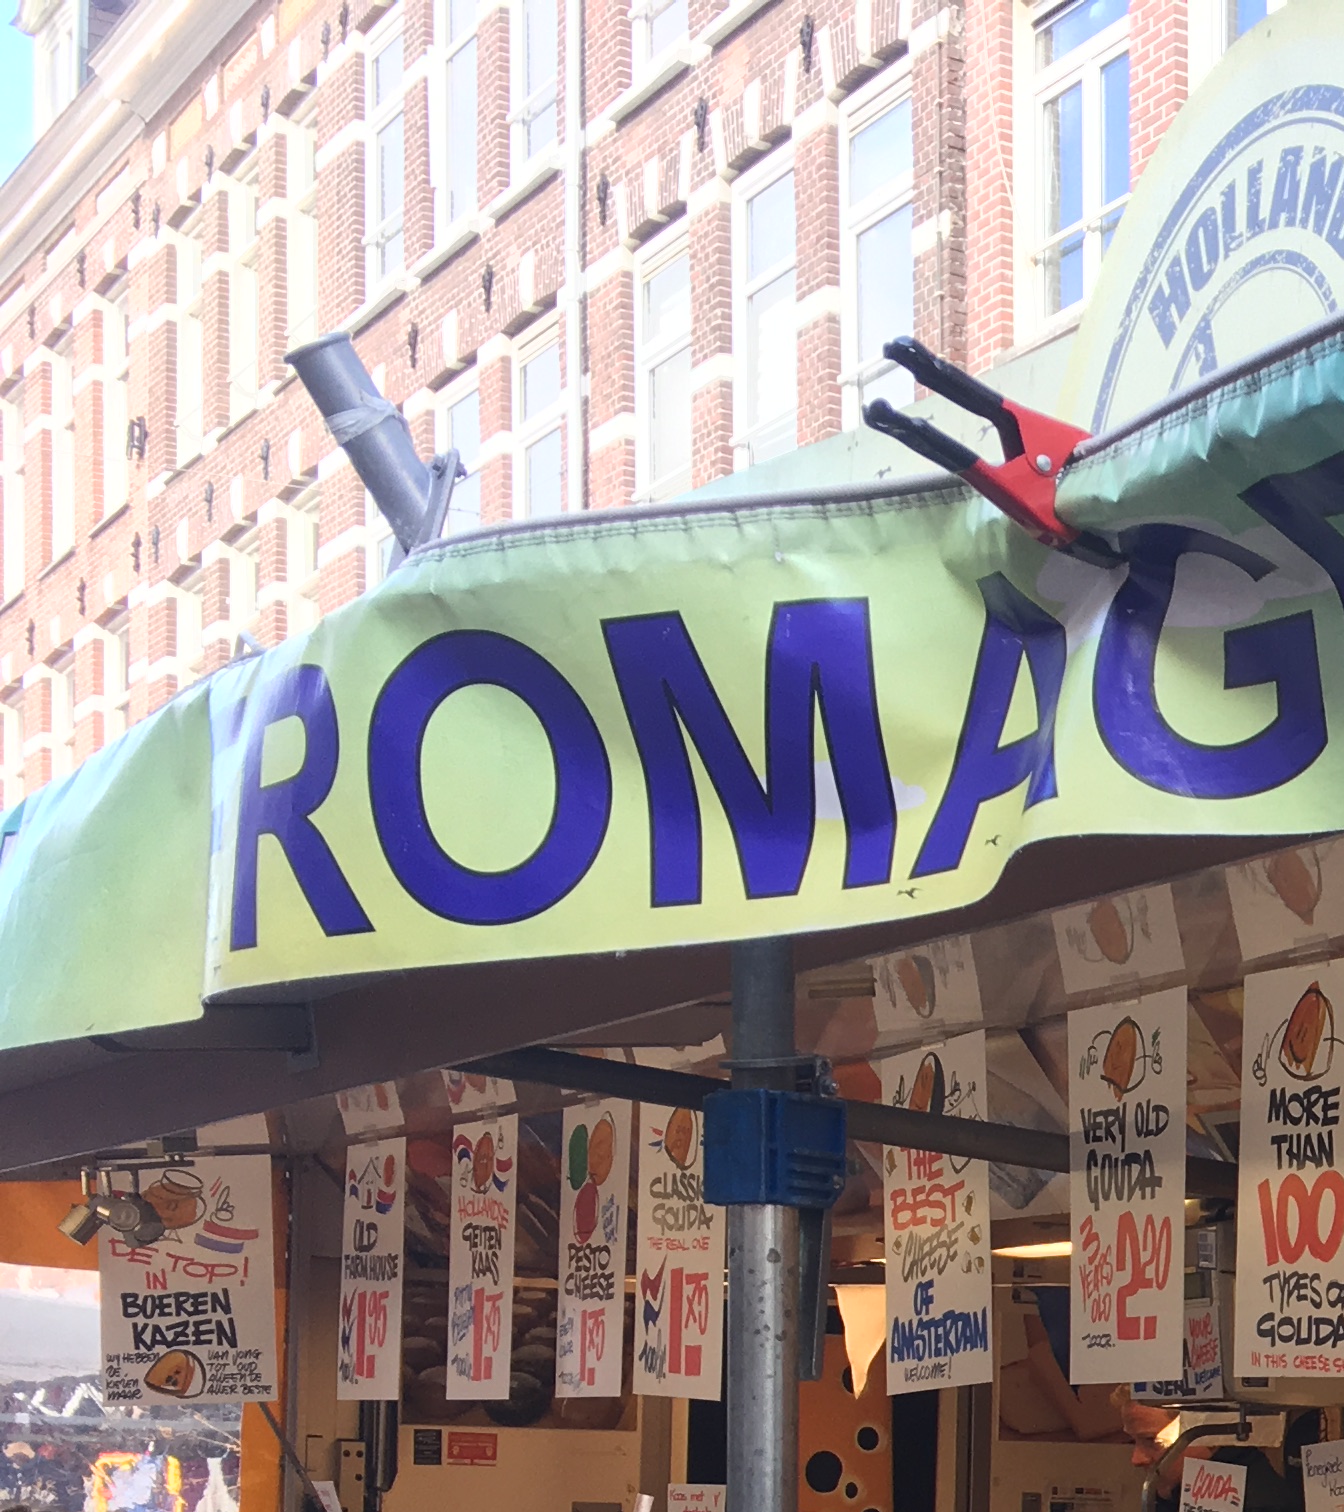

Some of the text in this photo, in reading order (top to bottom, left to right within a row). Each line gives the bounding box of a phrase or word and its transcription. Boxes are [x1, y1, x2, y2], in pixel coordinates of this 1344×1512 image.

[1267, 1085, 1340, 1127] MORE
[1080, 1099, 1169, 1152] VERY OLD
[901, 1146, 944, 1181] THE
[1270, 1130, 1335, 1170] THAN
[650, 1172, 704, 1202] CLASSI
[1086, 1149, 1163, 1211] GOUDA
[652, 1203, 714, 1236] GOUDA
[890, 1180, 965, 1231] BEST
[353, 1219, 378, 1253] OLD
[462, 1222, 502, 1251] GEITEN
[648, 1236, 710, 1251] THE REAL ONE
[902, 1221, 965, 1283] CHEESE
[1079, 1215, 1100, 1265] 3
[166, 1252, 248, 1287] TOP!
[471, 1250, 499, 1286] KAAS
[568, 1243, 610, 1273] PESTO
[145, 1269, 167, 1290] IN
[564, 1271, 615, 1301] CHEESE
[1079, 1245, 1113, 1313] YEARS
[1262, 1271, 1323, 1314] TYPES
[121, 1288, 232, 1319] BOEREN
[914, 1278, 934, 1316] OF
[1091, 1292, 1112, 1323] OLD
[132, 1317, 238, 1351] KAZEN
[890, 1306, 988, 1364] AMSTERDAM
[122, 1352, 161, 1364] HEBBEN
[206, 1361, 258, 1373] TOT OUD
[208, 1349, 263, 1366] VAN JONG
[1251, 1351, 1261, 1368] IN
[1264, 1354, 1288, 1369] THIS
[1293, 1354, 1331, 1372] CHEESE
[107, 1389, 143, 1400] MAAR
[240, 1384, 273, 1395] BESTE
[1192, 1465, 1238, 1505] GOUDA
